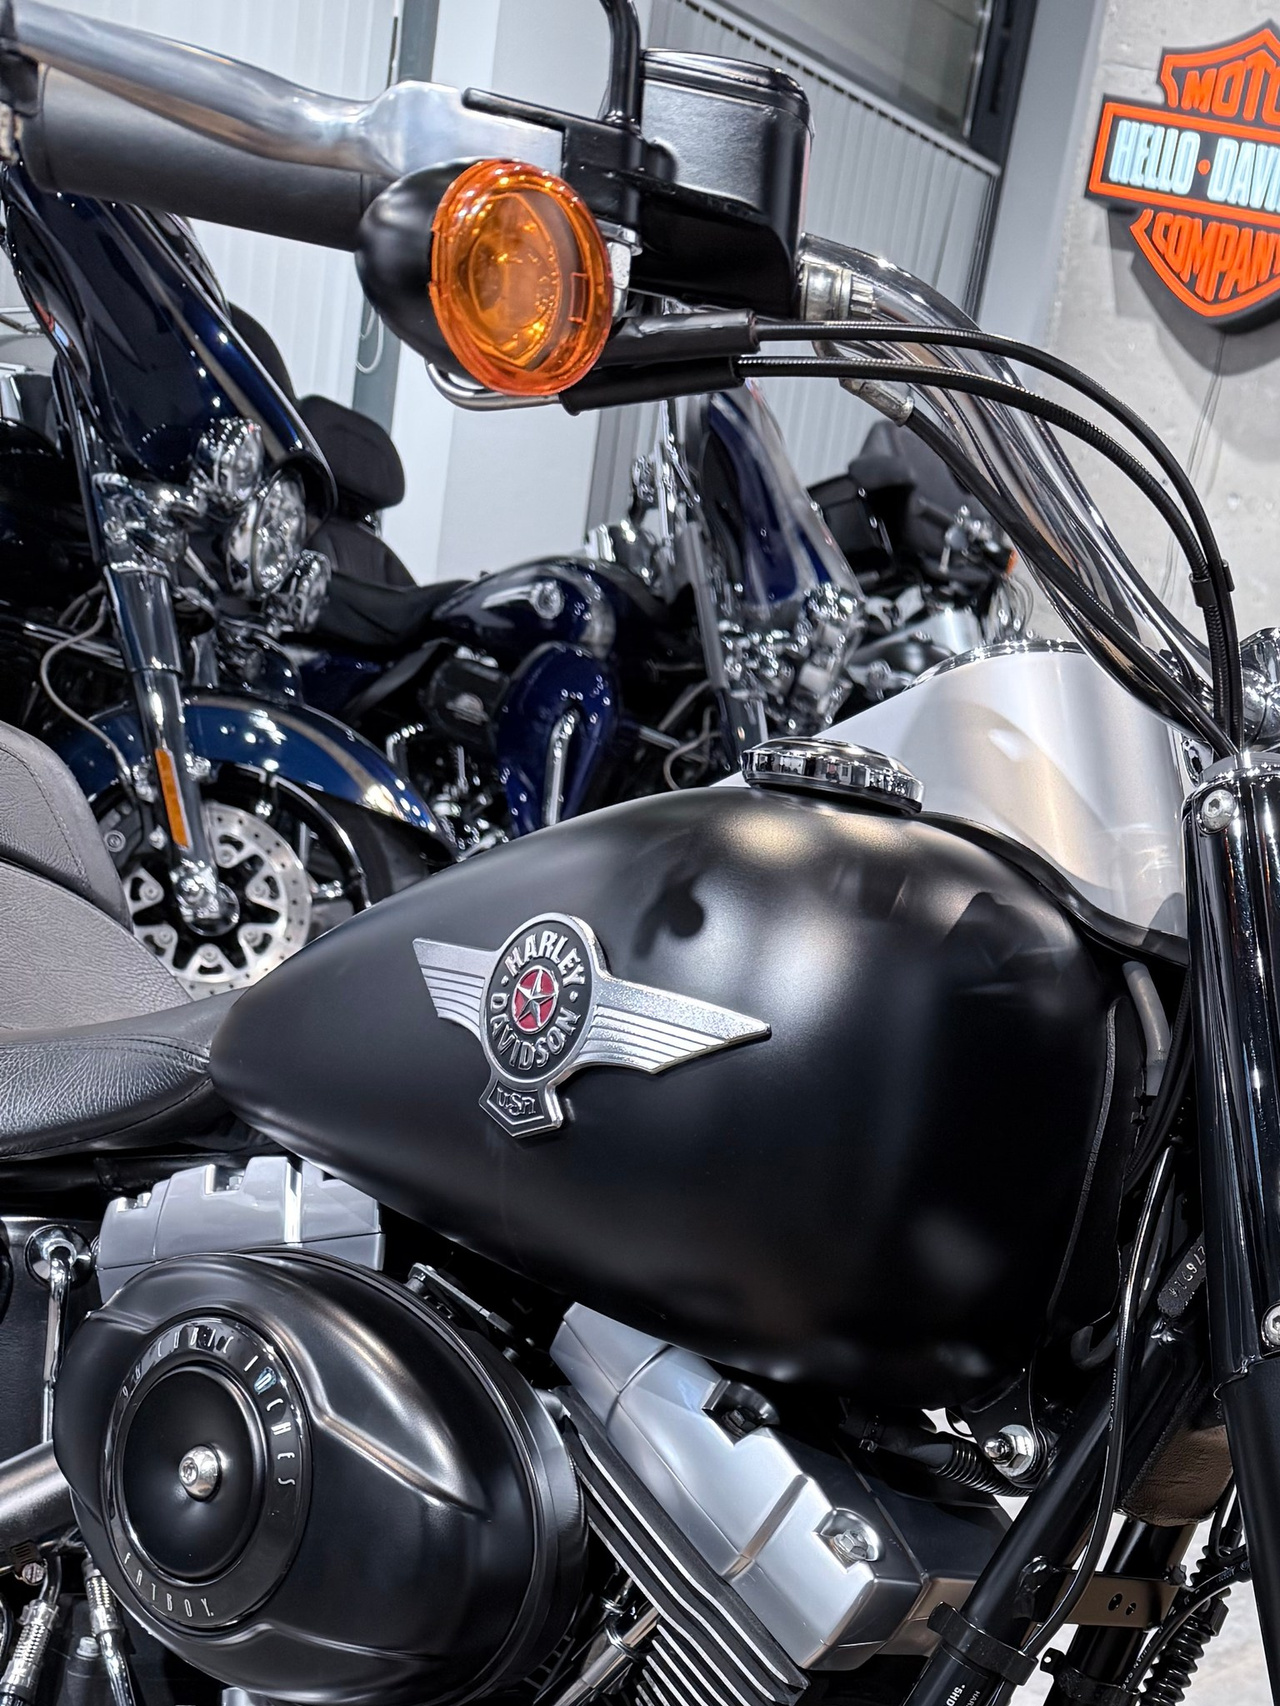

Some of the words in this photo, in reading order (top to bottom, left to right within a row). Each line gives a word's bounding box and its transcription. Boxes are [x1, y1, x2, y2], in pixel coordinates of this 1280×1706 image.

[1109, 119, 1200, 195] HELLO
[505, 930, 586, 987] HARLEY
[491, 992, 581, 1071] DAVIDSON
[496, 1089, 537, 1117] USA
[156, 1325, 235, 1358] CUBIC
[244, 1355, 296, 1486] INCHES
